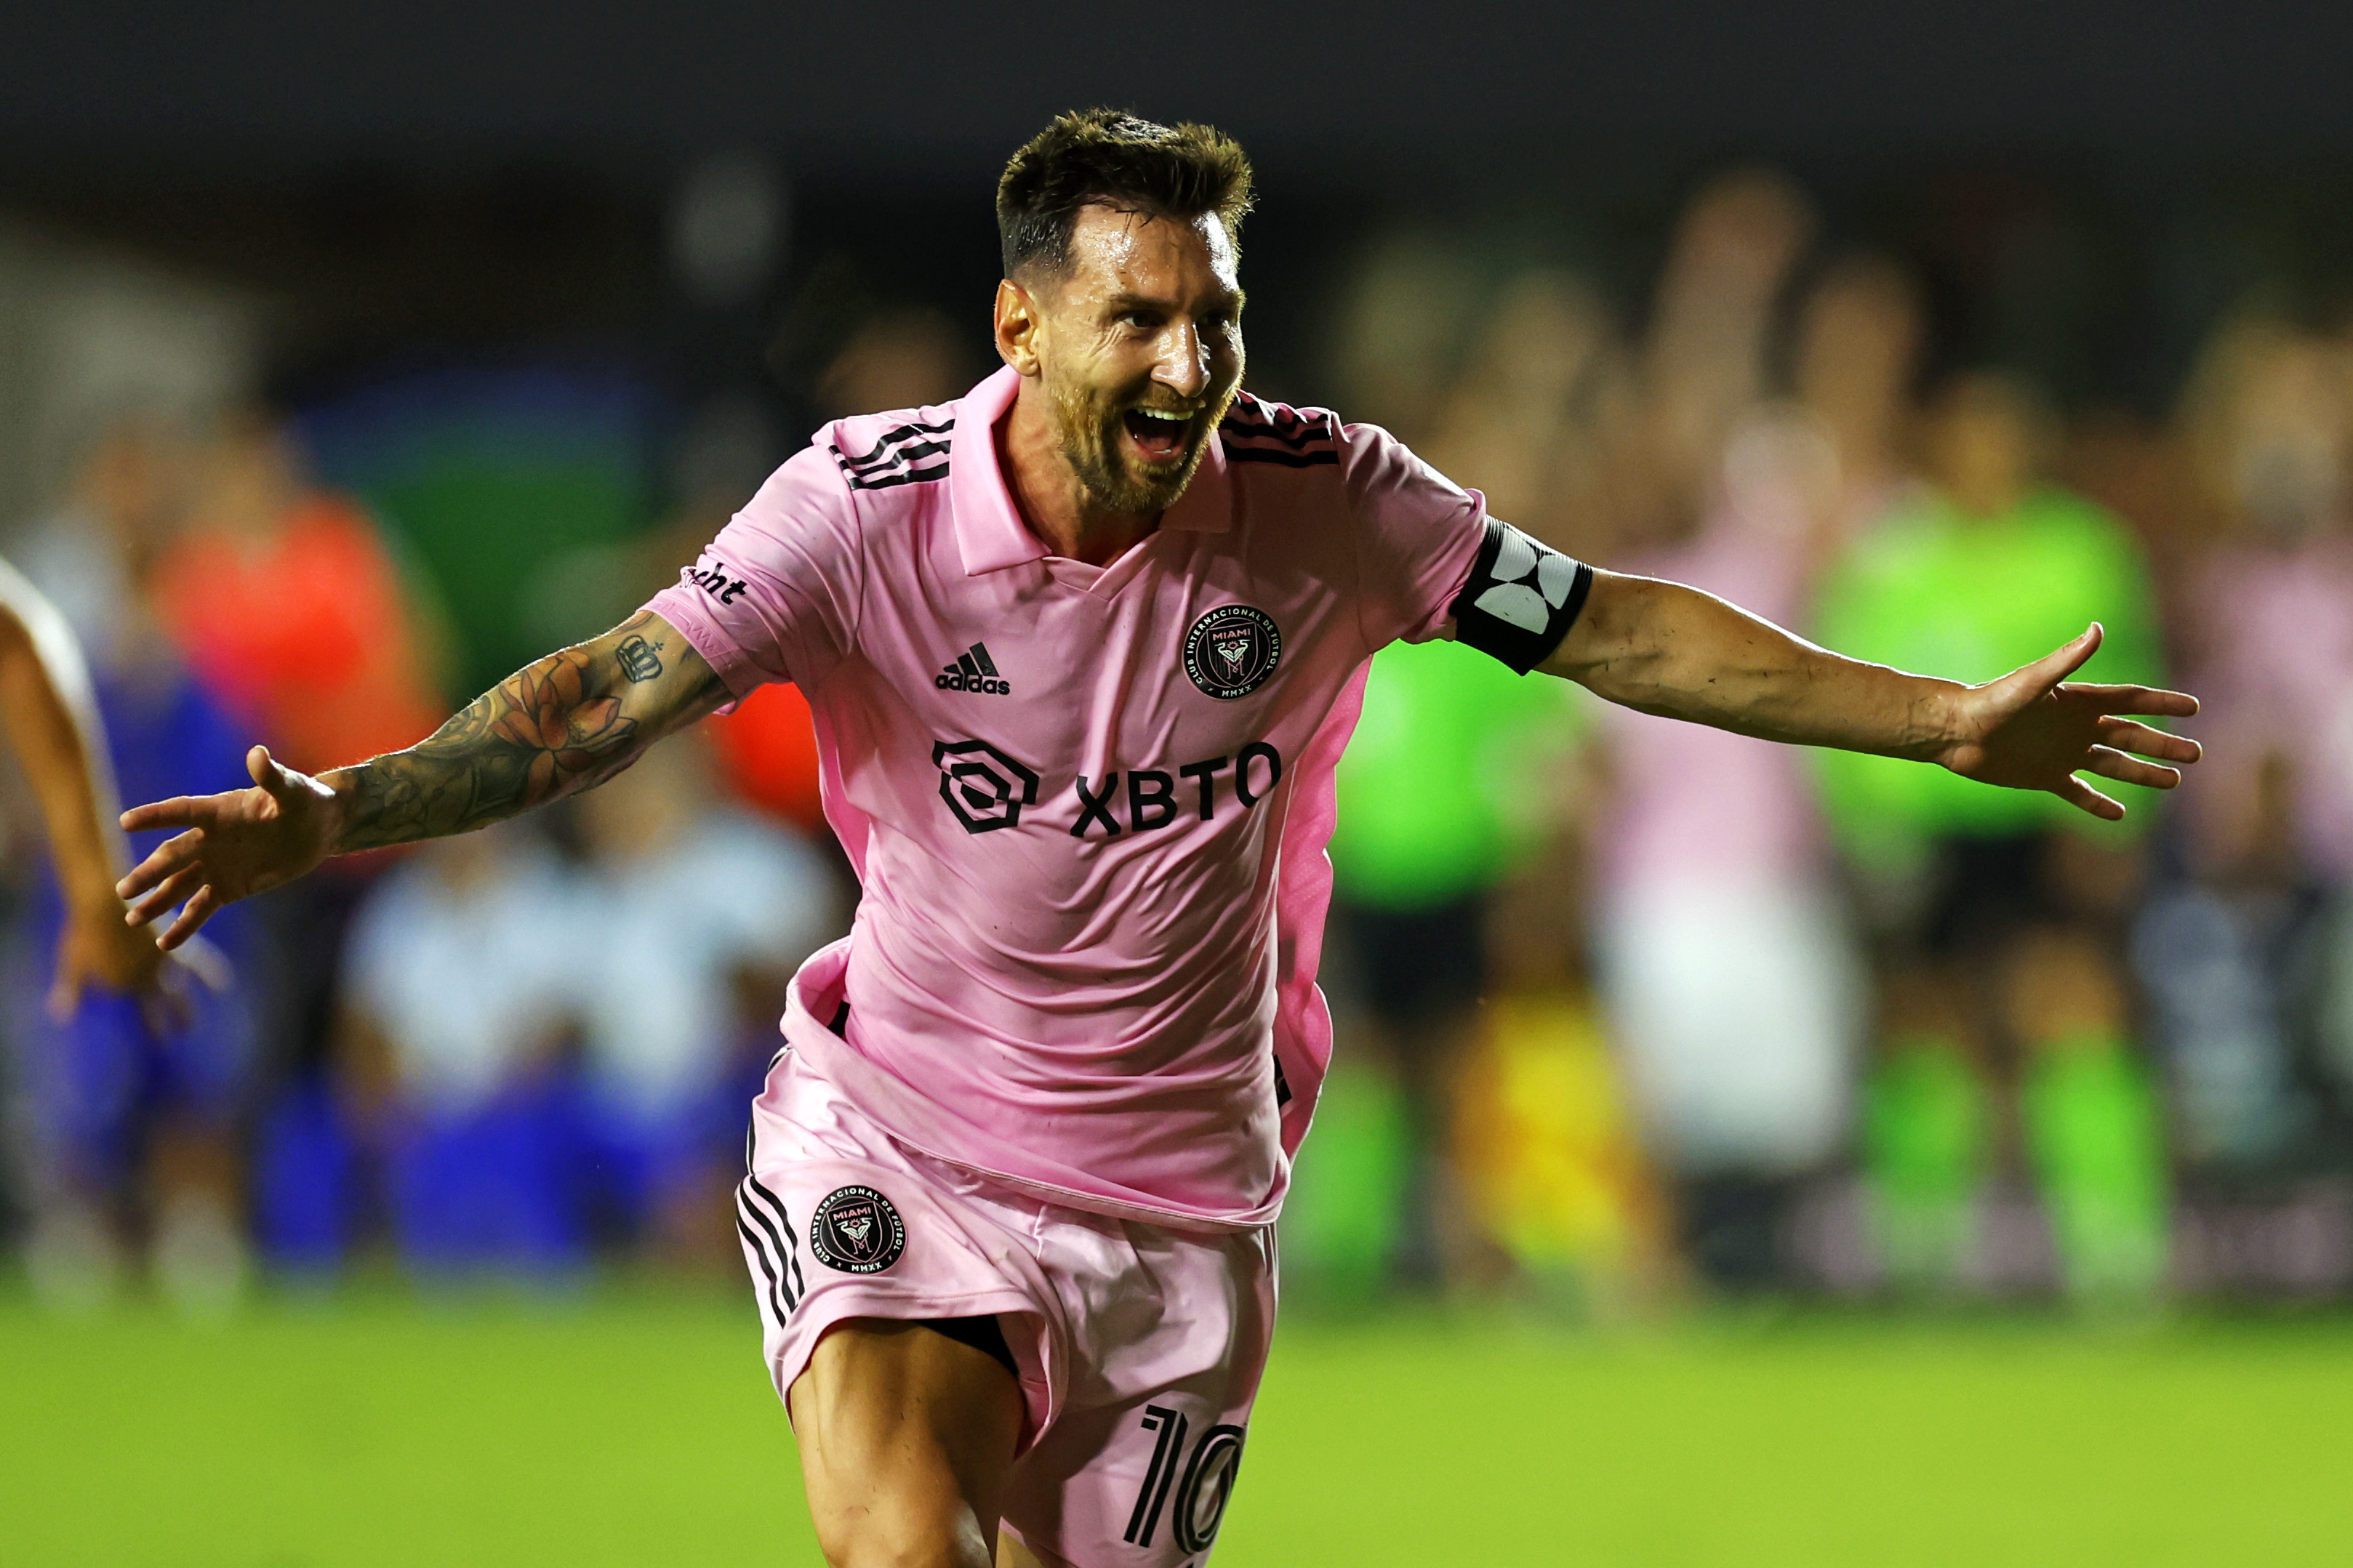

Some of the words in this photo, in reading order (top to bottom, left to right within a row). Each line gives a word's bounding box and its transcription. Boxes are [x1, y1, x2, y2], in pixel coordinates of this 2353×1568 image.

[1187, 608, 1261, 654] INTERNACIONAL
[1212, 628, 1251, 641] MIAMI
[1263, 619, 1274, 632] DE
[1187, 659, 1203, 684] CLUB
[935, 672, 1011, 695] adidas
[1222, 685, 1252, 697] MMXX
[1070, 741, 1282, 838] XBTO
[812, 1187, 878, 1239] INTERNACIONAL
[833, 1207, 872, 1221] MIAMI
[881, 1200, 894, 1213] DE
[813, 1242, 830, 1262] CLUB
[851, 1261, 883, 1271] MMXX
[1123, 1404, 1244, 1555] 10
